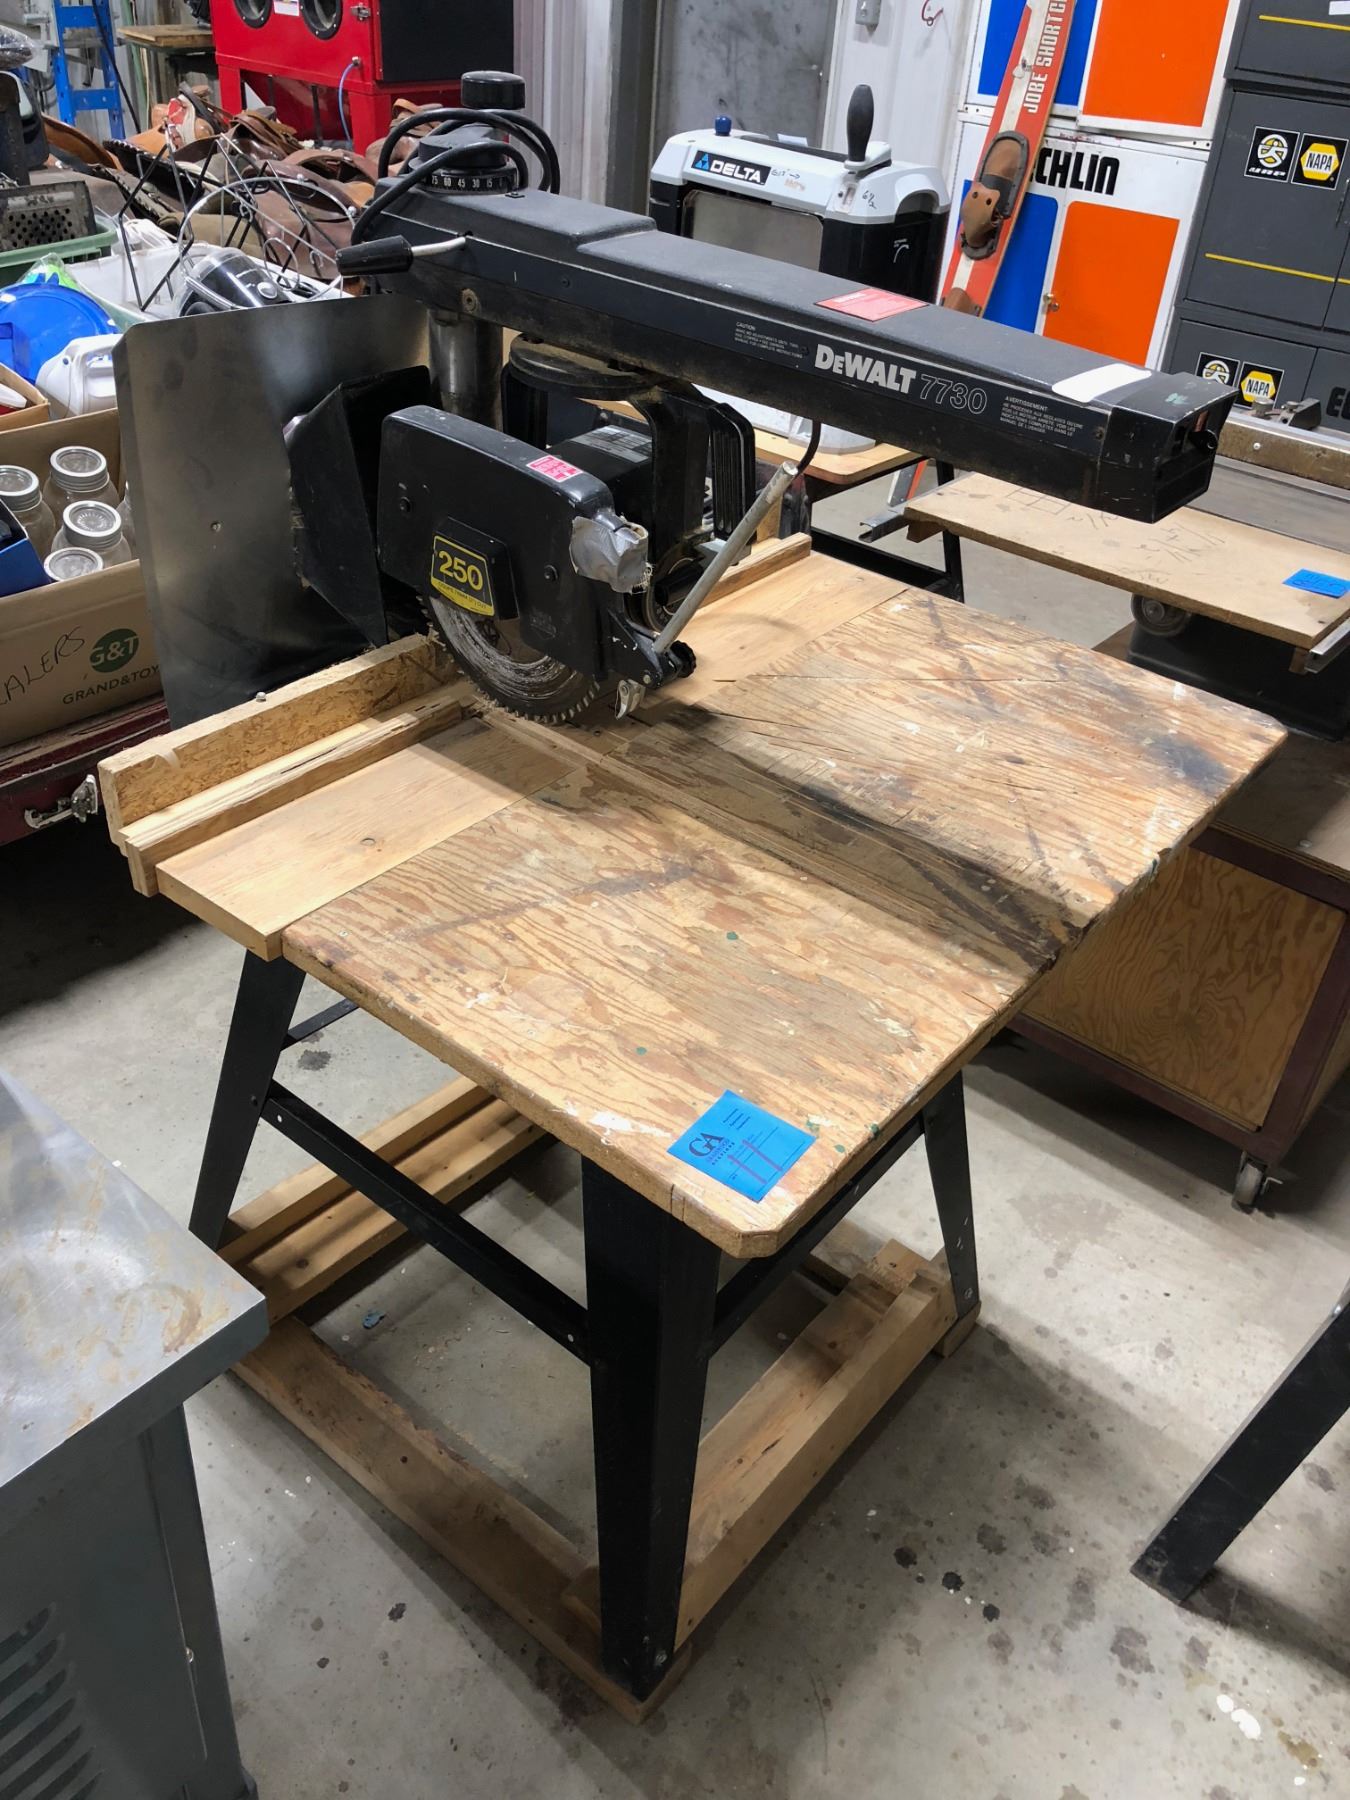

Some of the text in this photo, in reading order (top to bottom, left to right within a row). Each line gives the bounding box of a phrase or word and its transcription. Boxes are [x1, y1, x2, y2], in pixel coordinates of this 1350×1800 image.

[1023, 0, 1067, 114] JOBE SHORTC
[710, 159, 761, 184] DELTA
[1031, 147, 1120, 195] CHLIN
[1306, 152, 1333, 172] NAPA
[443, 177, 452, 188] 60
[457, 178, 466, 189] 45
[472, 178, 480, 189] 30
[920, 373, 988, 415] 7730
[1245, 379, 1270, 397] NAPA
[438, 550, 484, 592] 250
[0, 626, 85, 706] ALERS
[89, 636, 141, 667] G&T
[62, 664, 160, 705] GRAND&TOY
[688, 1132, 726, 1158] GA
